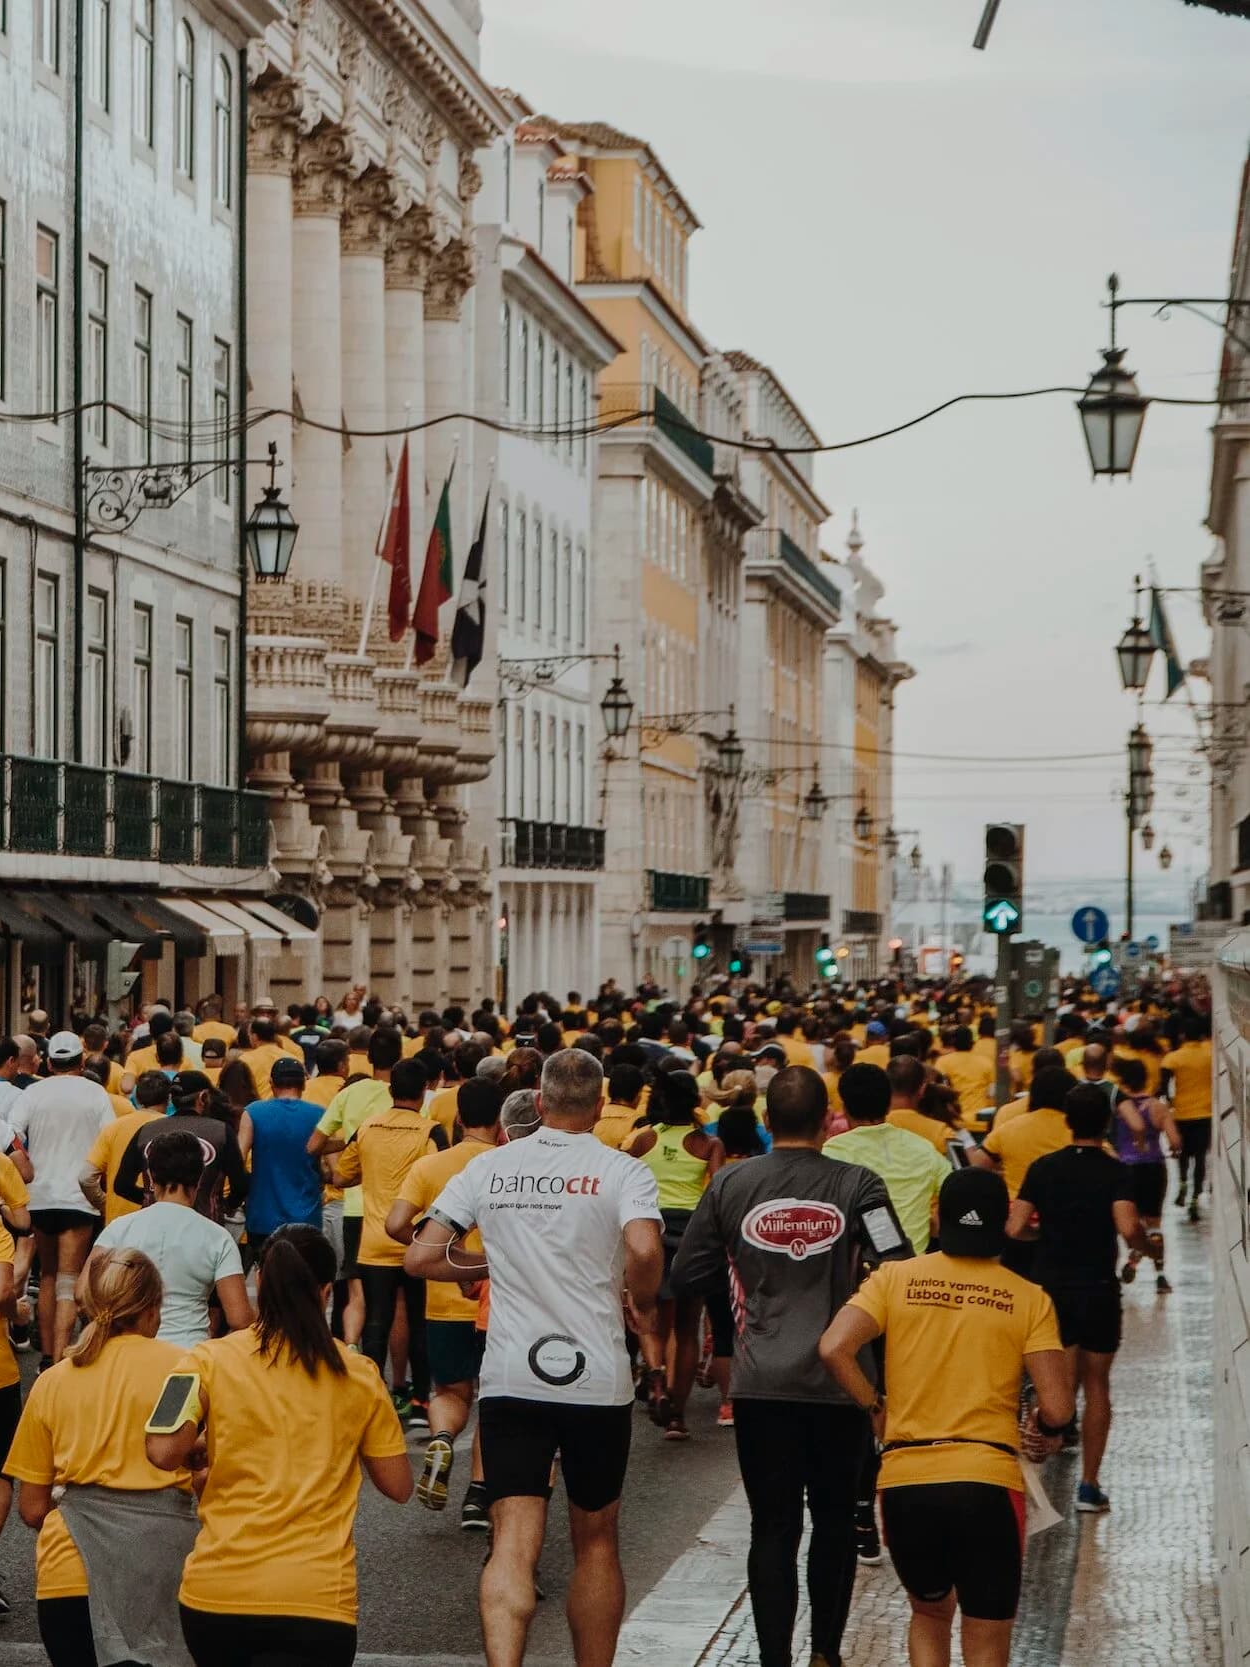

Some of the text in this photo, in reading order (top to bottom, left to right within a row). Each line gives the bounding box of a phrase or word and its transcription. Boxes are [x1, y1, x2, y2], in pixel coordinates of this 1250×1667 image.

[758, 1219, 833, 1233] Millennium
[949, 1281, 990, 1293] vamos
[907, 1288, 951, 1301] Lisboa
[955, 1295, 964, 1304] a
[967, 1295, 1015, 1315] correr!
